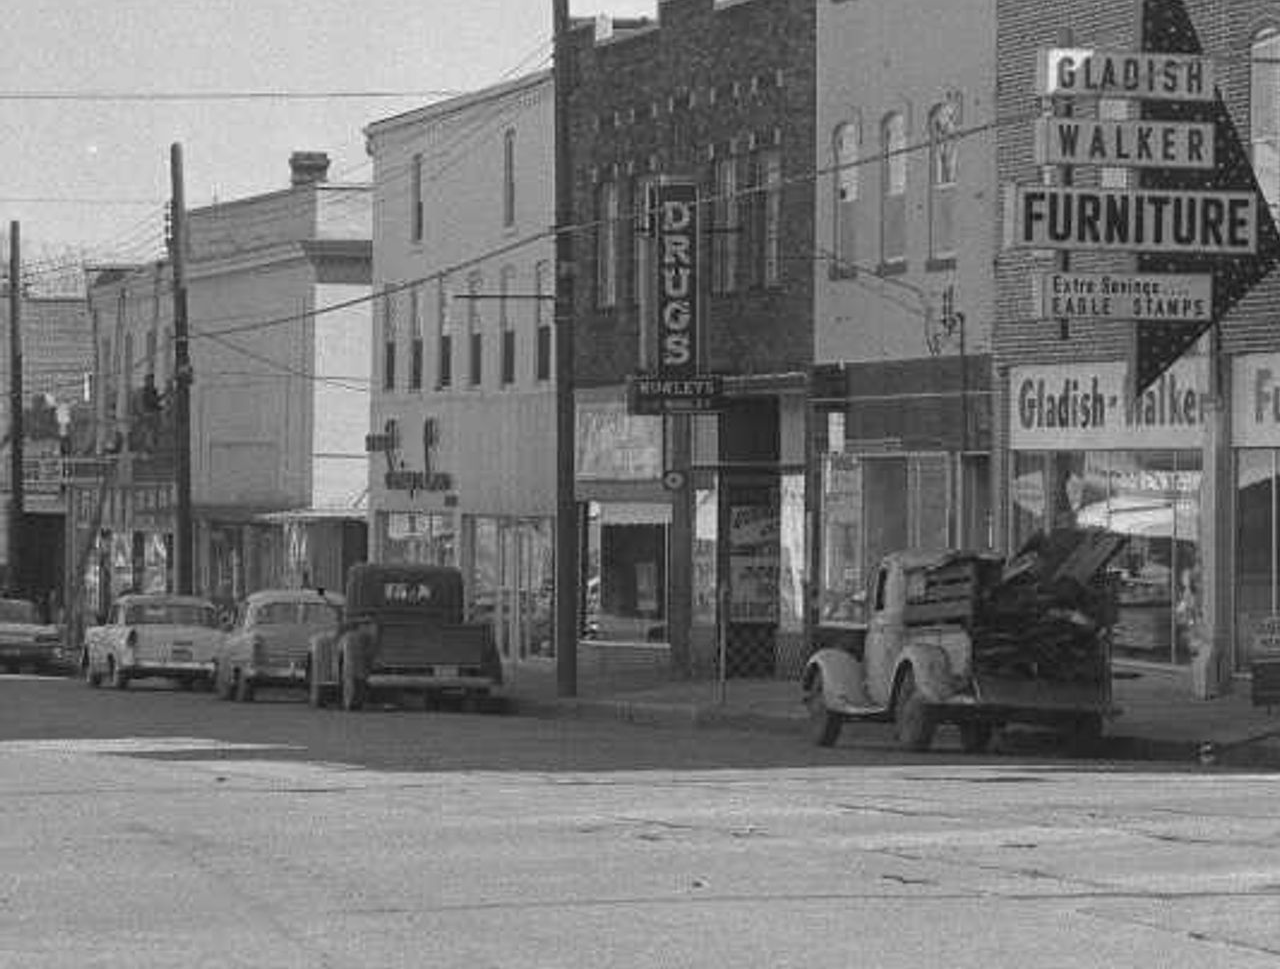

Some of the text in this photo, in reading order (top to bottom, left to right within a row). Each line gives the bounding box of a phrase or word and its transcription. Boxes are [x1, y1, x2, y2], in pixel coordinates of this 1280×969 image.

[1057, 56, 1204, 93] GLADISH
[1058, 124, 1203, 161] WALKER
[1023, 191, 1249, 248] FURNITURE
[663, 200, 691, 365] DRUGS
[1052, 297, 1206, 317] EAGLE STAMPS
